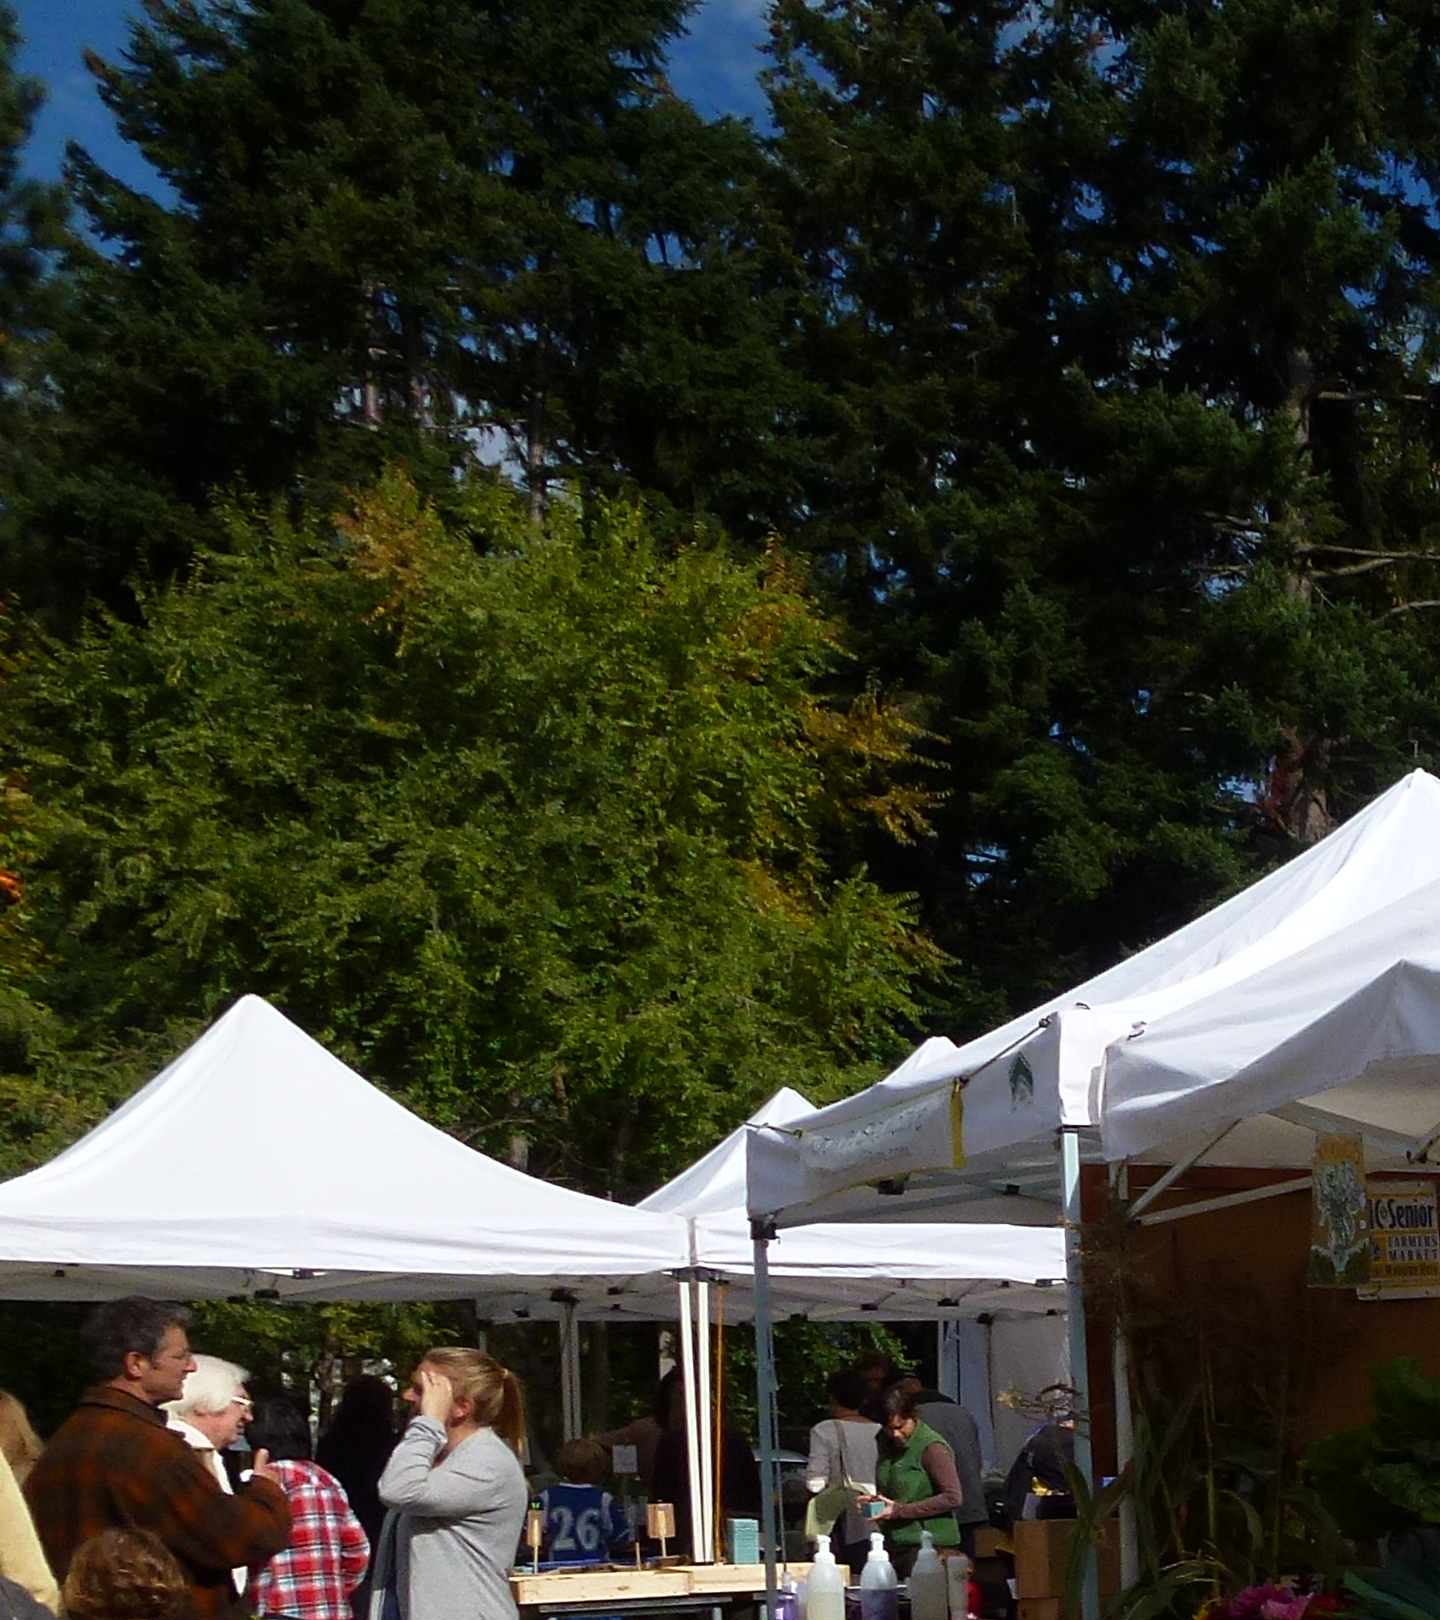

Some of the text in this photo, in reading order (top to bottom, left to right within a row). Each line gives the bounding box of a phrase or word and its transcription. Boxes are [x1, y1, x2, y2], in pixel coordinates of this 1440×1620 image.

[1386, 1198, 1435, 1229] Senior
[1388, 1235, 1438, 1248] FARMERS
[1388, 1248, 1438, 1261] MARKET
[551, 1506, 600, 1551] 26
